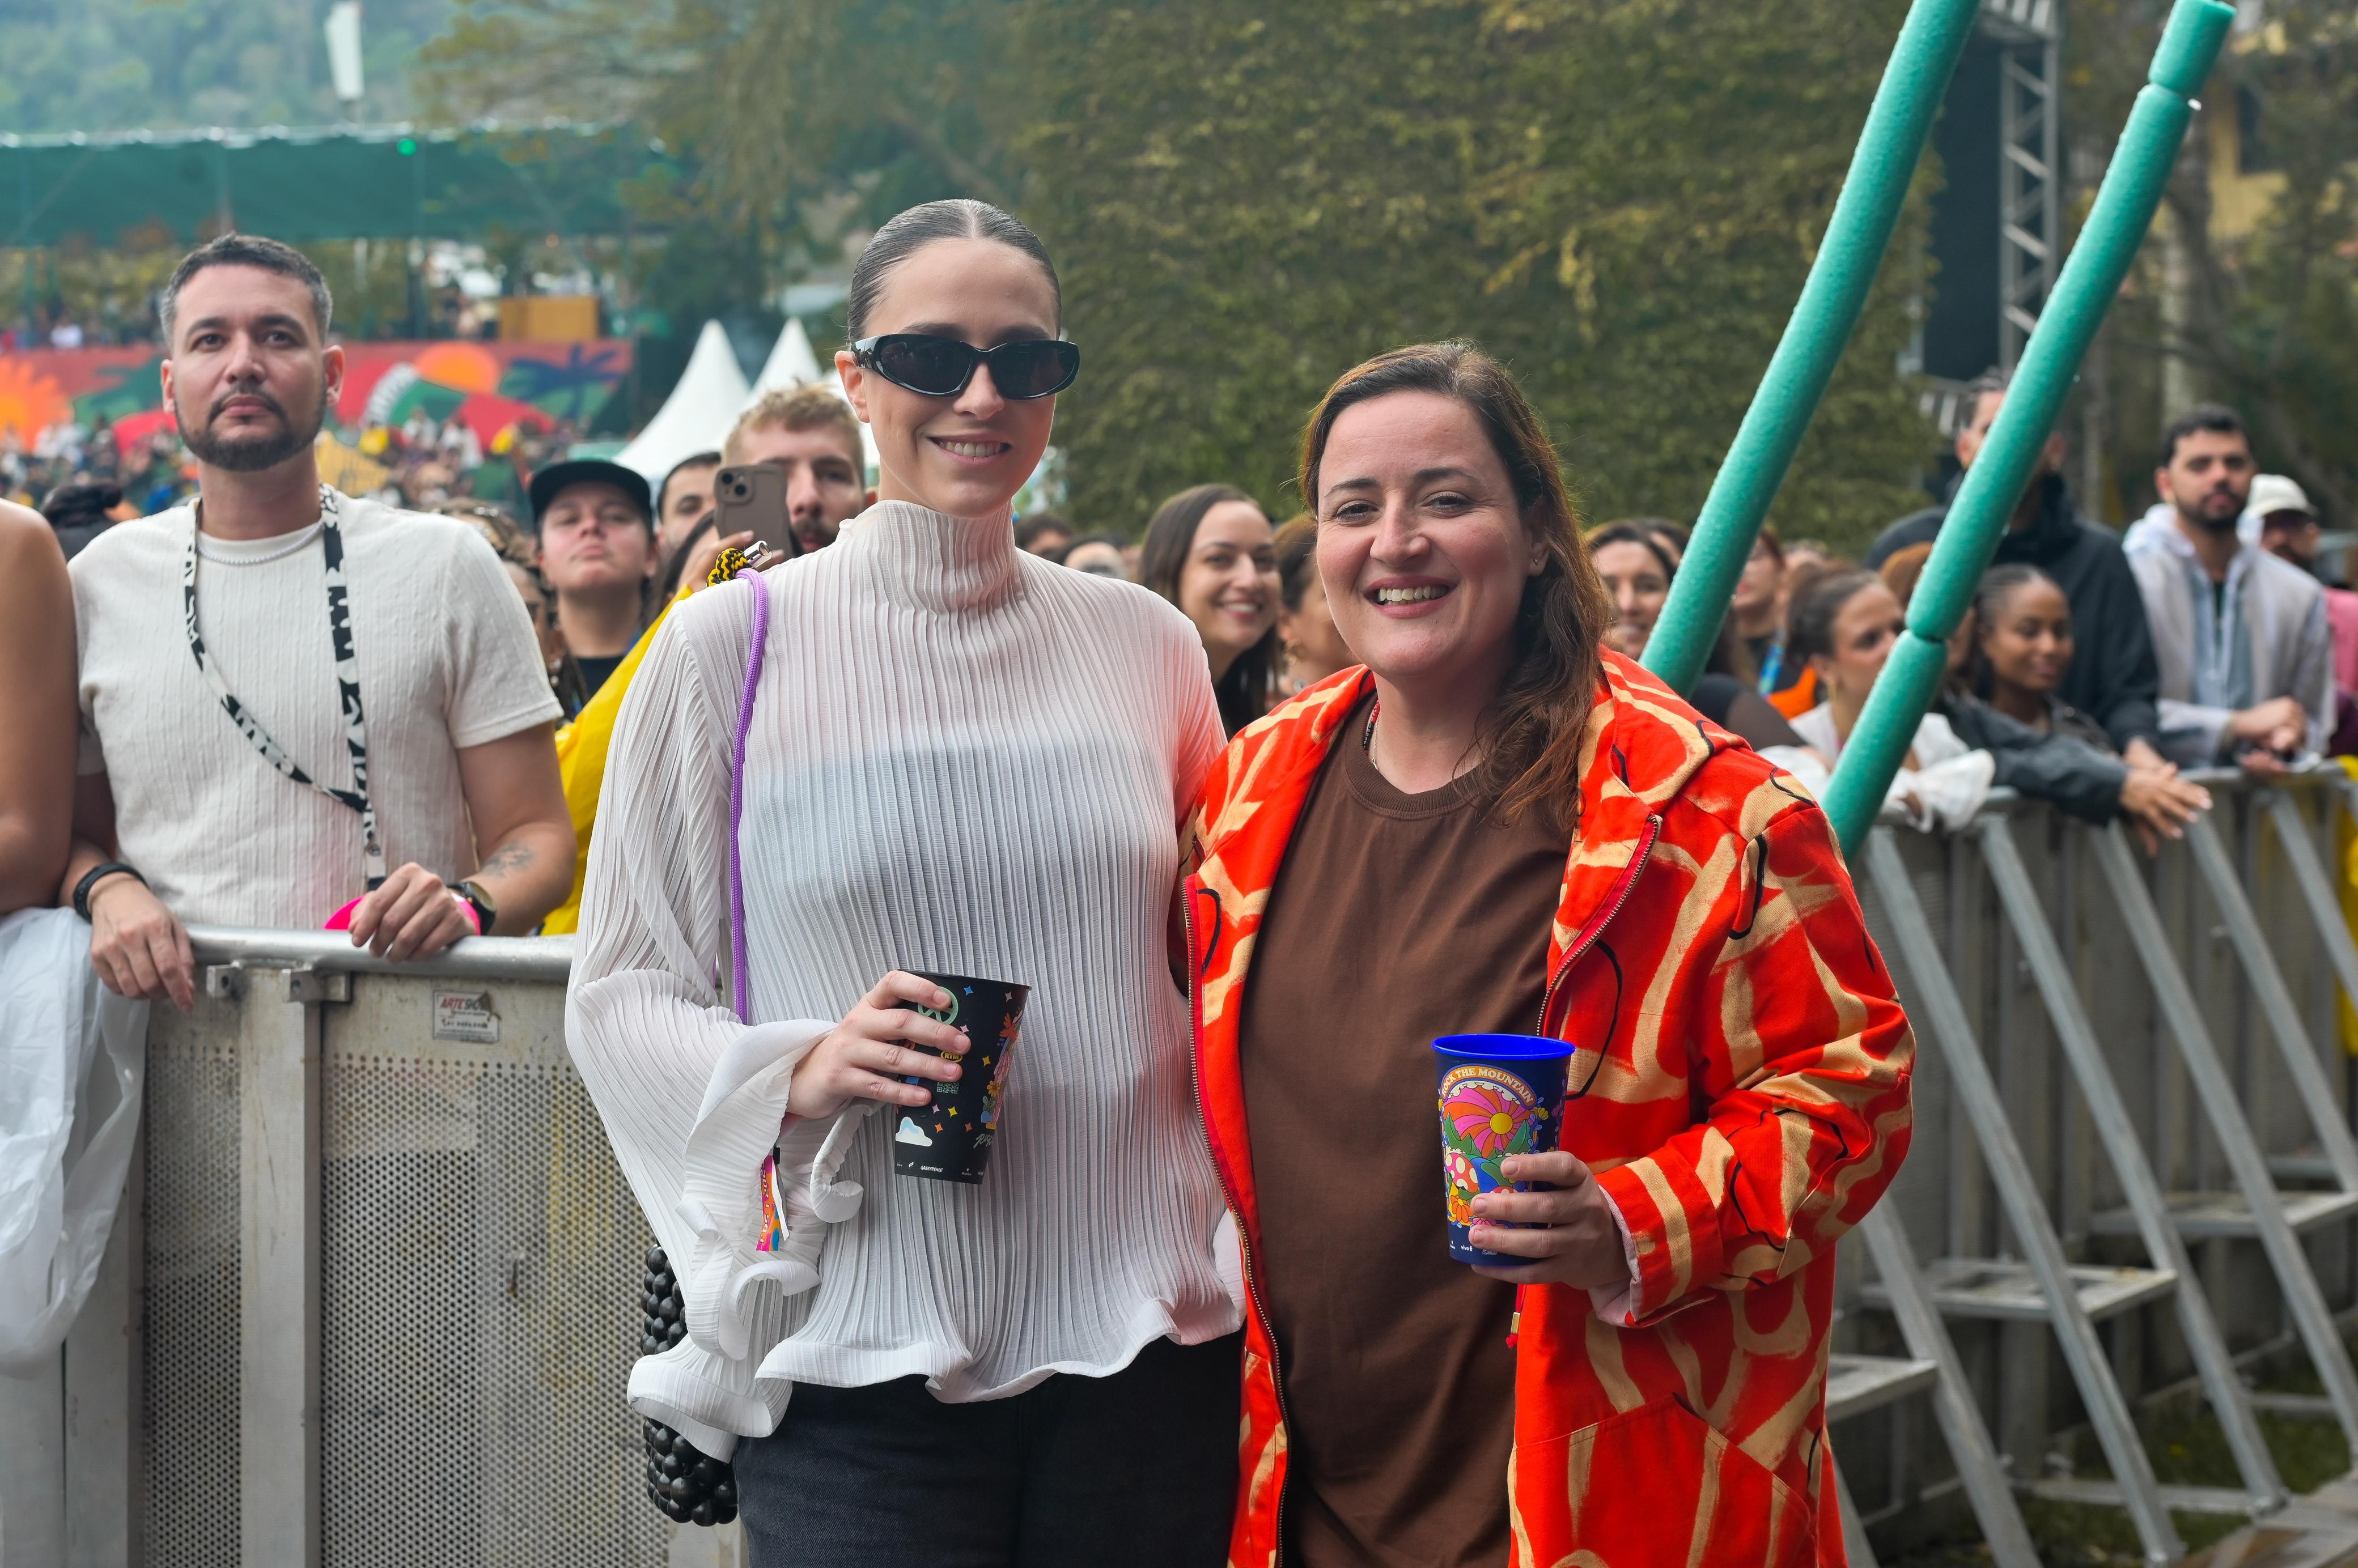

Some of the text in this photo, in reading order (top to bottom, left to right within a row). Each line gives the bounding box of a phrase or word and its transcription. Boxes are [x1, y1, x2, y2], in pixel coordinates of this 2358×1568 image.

[1441, 1068, 1533, 1103] ROCK THE MOUNTAIN
